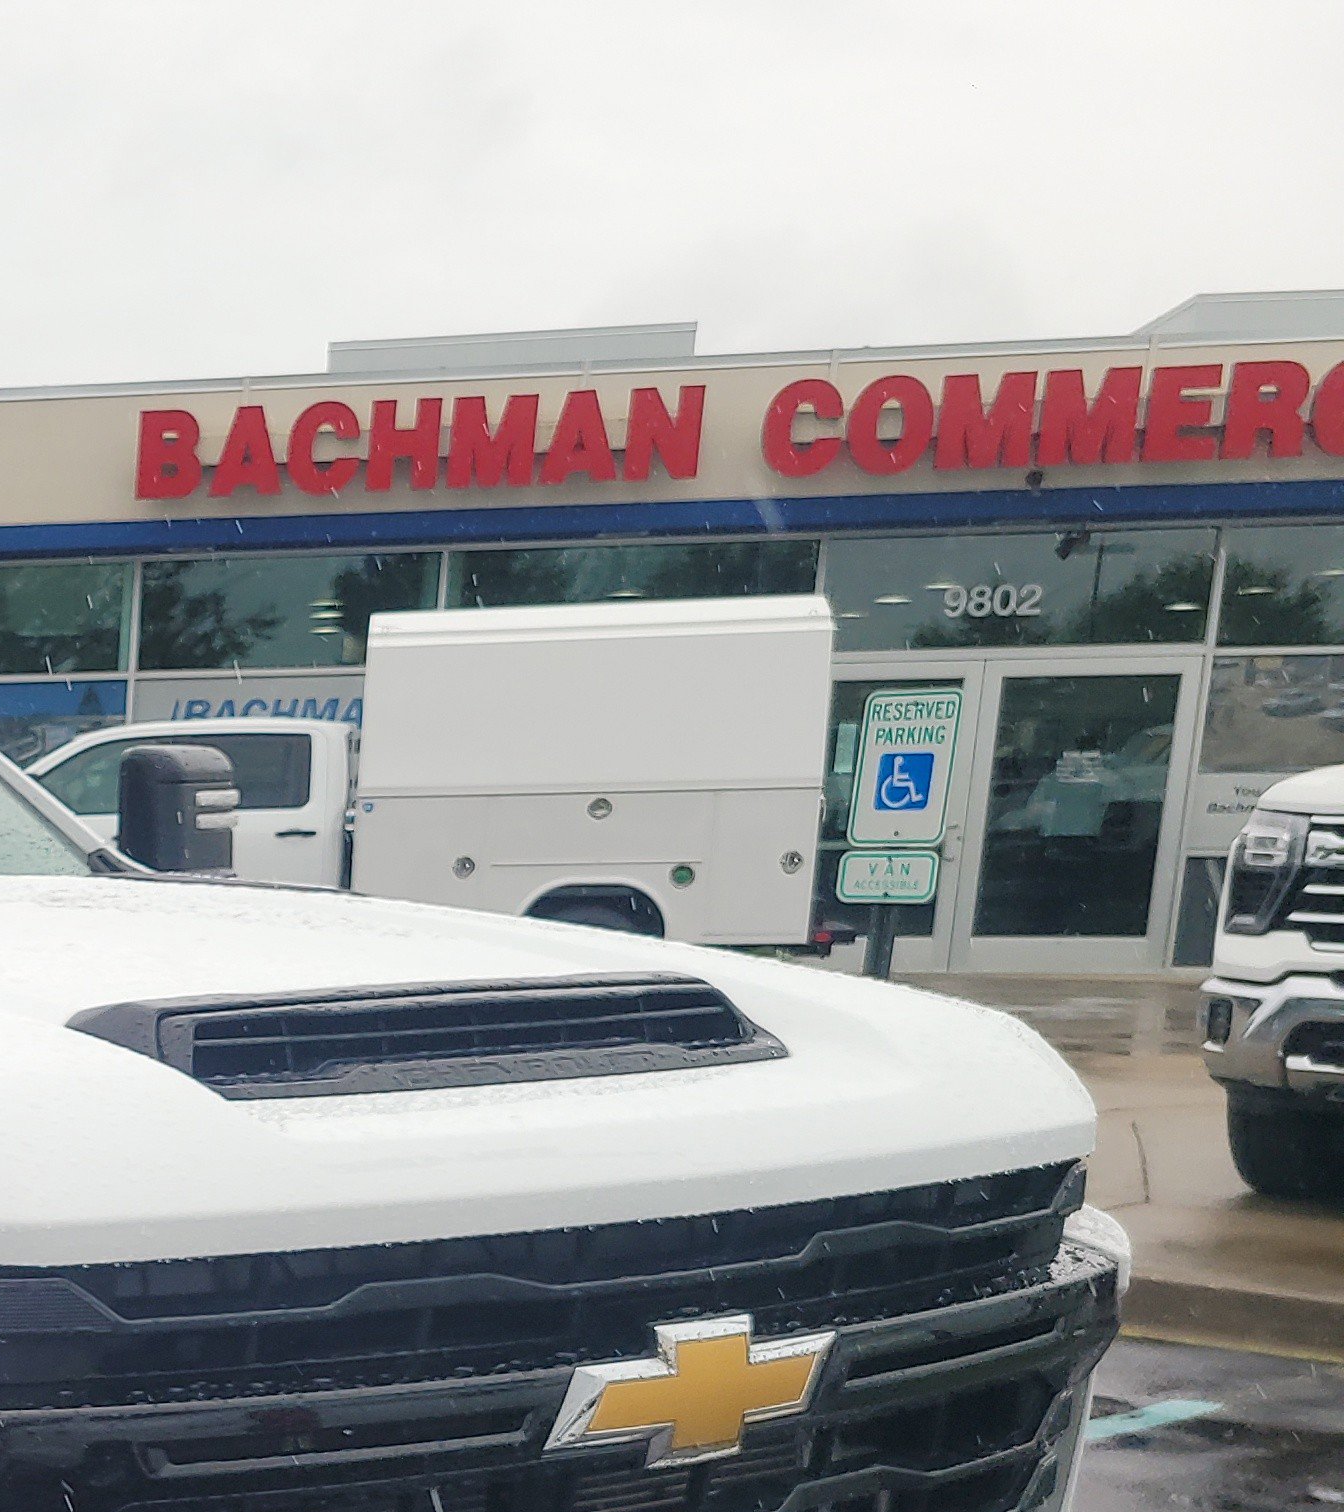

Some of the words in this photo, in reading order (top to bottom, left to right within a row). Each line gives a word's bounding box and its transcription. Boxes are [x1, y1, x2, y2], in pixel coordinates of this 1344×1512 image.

[134, 384, 707, 500] BACHMAN
[943, 584, 1043, 618] 9802
[870, 700, 957, 722] RESERVED
[874, 725, 947, 746] PARKING
[868, 862, 911, 876] VAN
